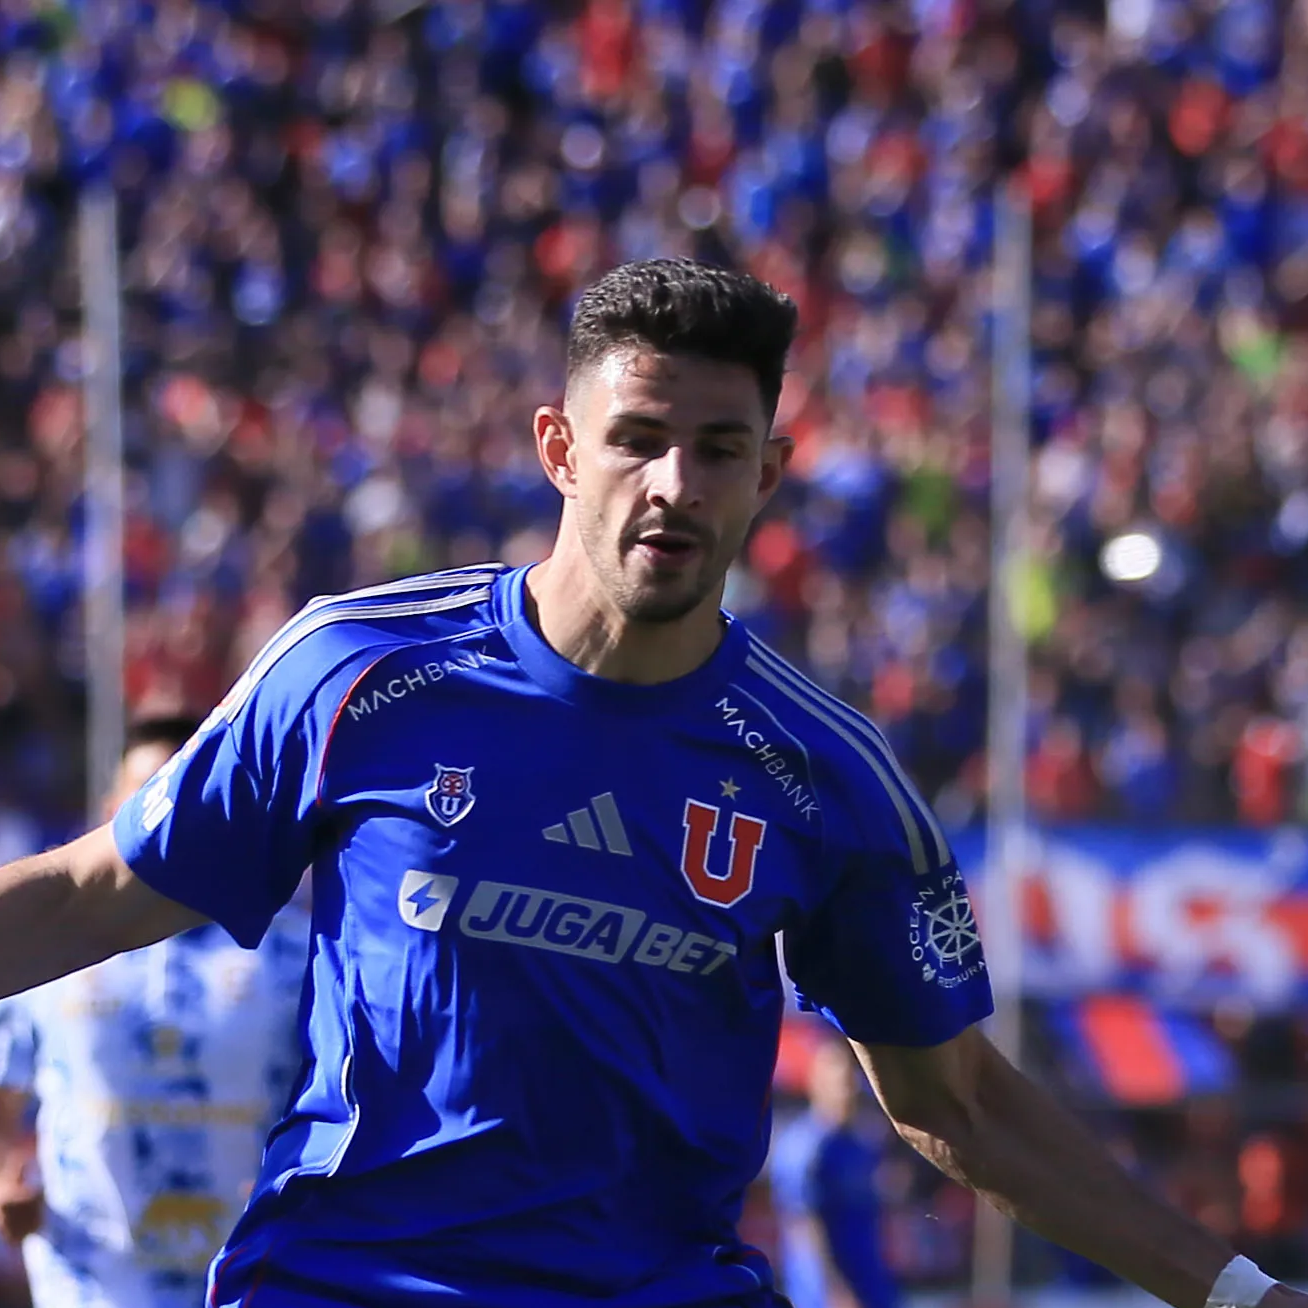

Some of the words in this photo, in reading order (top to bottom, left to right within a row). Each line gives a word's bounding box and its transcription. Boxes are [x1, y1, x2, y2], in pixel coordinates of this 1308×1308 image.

[347, 645, 496, 721] MACHBANK
[715, 697, 820, 821] MACHBANK
[680, 798, 767, 909] U
[909, 886, 936, 962] OCEAN
